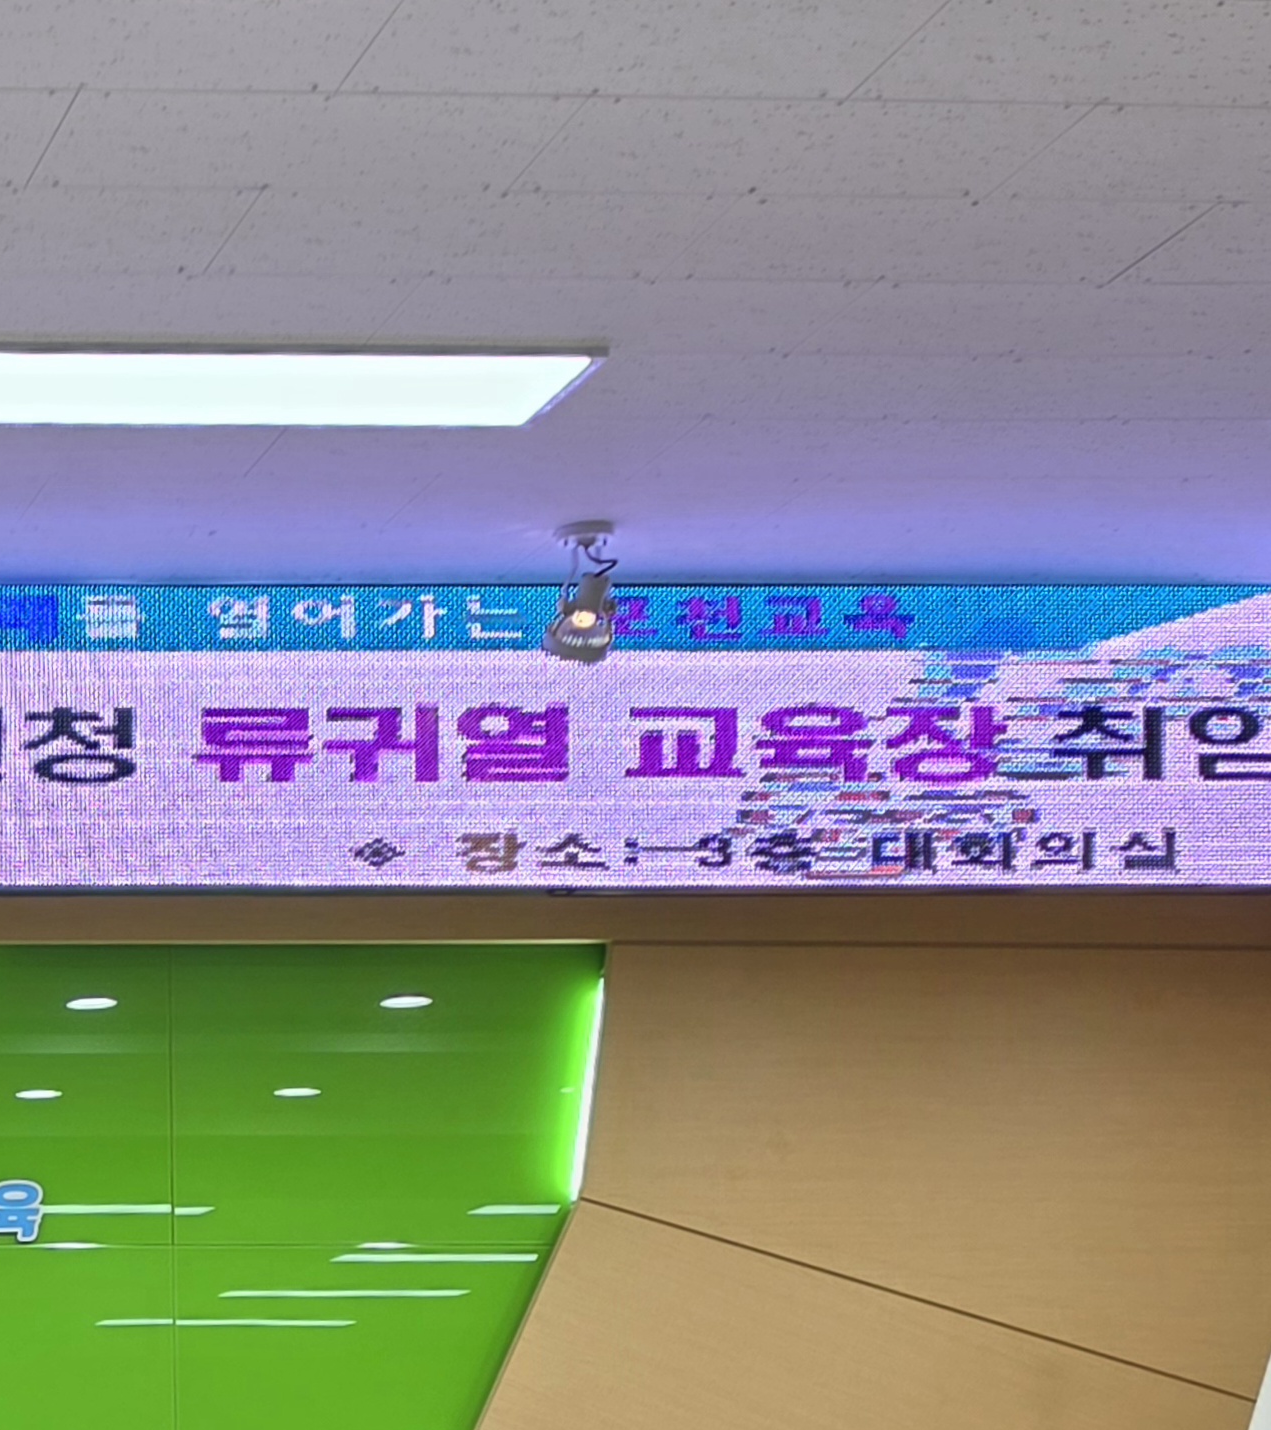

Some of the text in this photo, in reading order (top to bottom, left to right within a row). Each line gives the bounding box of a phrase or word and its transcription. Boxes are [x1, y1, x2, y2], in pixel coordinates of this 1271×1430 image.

[207, 592, 523, 642] 열어가는
[195, 702, 570, 784] 류귀열
[624, 702, 1009, 784] 교육장
